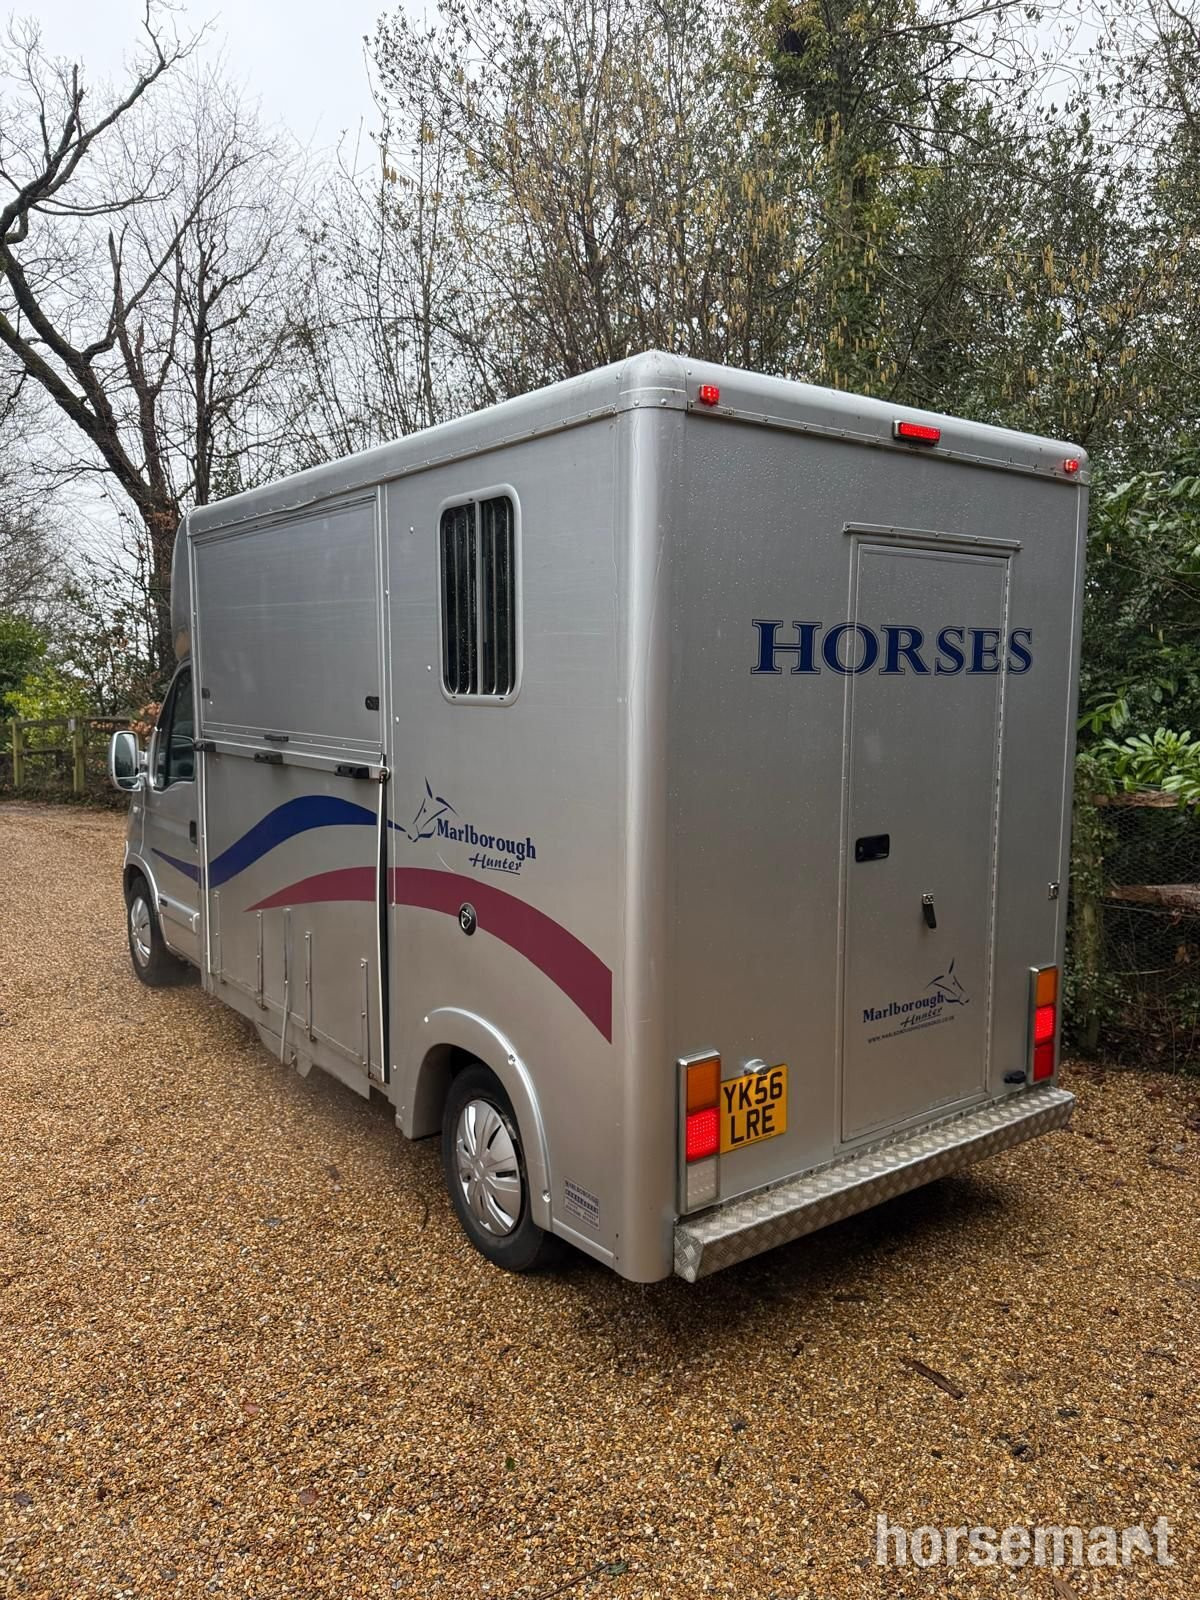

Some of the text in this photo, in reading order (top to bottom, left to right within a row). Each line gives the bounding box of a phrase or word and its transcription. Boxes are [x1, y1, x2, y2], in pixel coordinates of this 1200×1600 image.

[750, 618, 1033, 677] HORSES
[437, 818, 537, 861] Marlborough
[468, 852, 522, 872] Hunter
[862, 991, 945, 1024] Marlborough
[900, 1006, 943, 1028] Hunter
[723, 1071, 783, 1114] YK56
[730, 1103, 776, 1145] LRE
